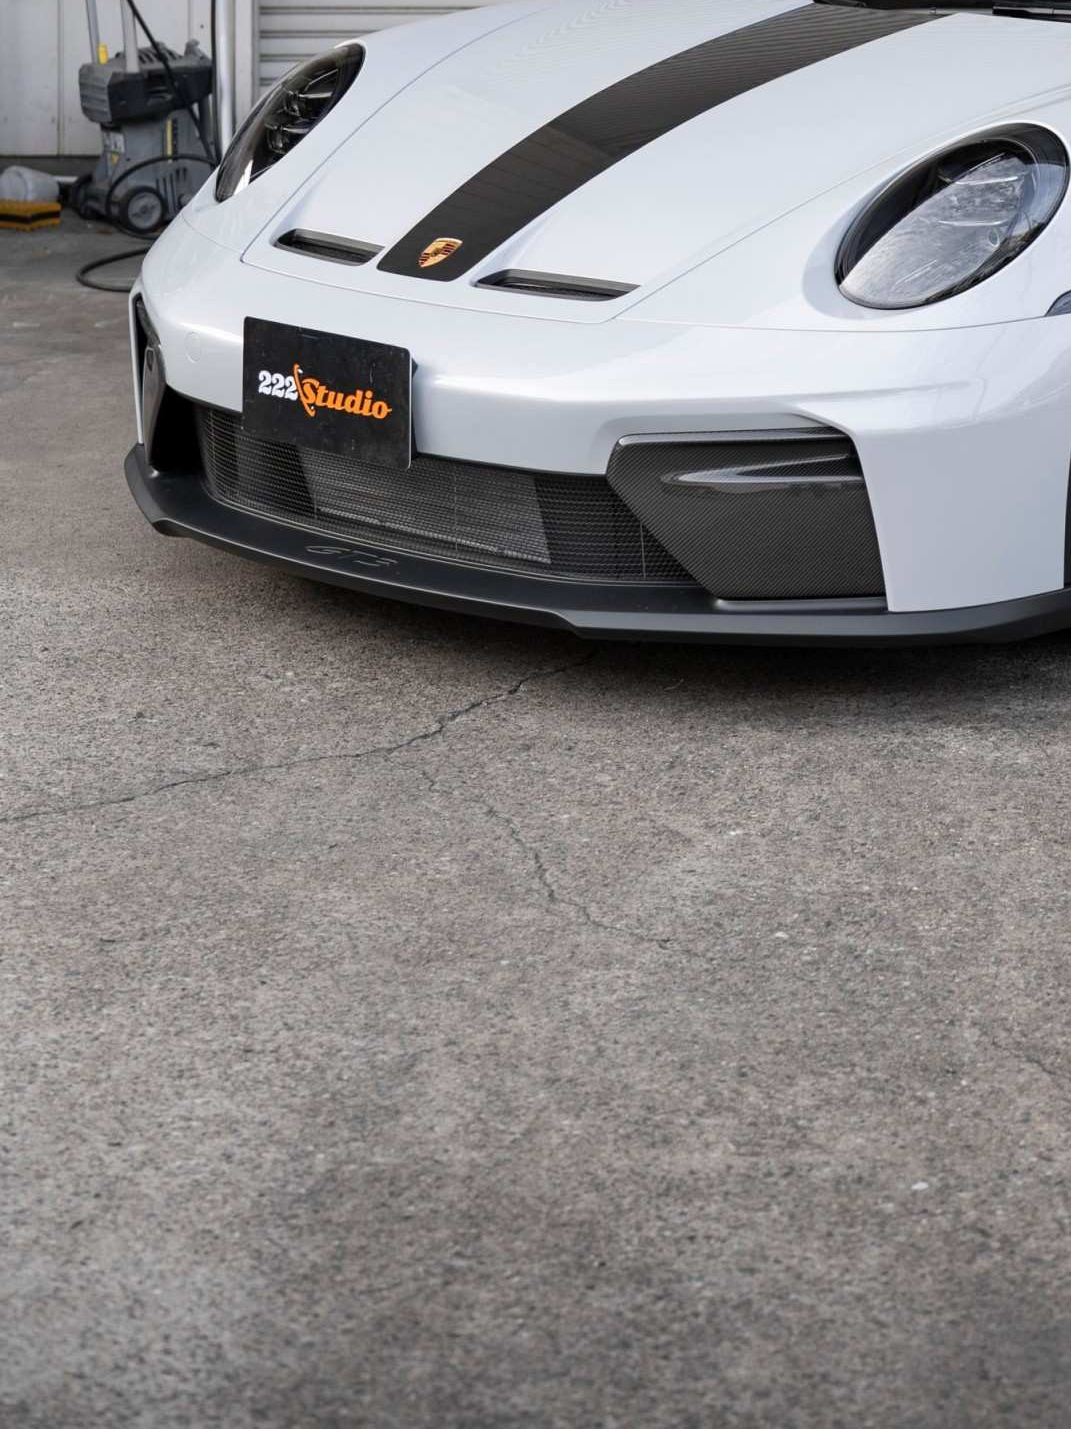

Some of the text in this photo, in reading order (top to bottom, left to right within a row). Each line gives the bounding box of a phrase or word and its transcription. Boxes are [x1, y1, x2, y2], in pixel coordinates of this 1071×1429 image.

[258, 370, 392, 419] 222 Studio
[304, 545, 399, 568] GT3
